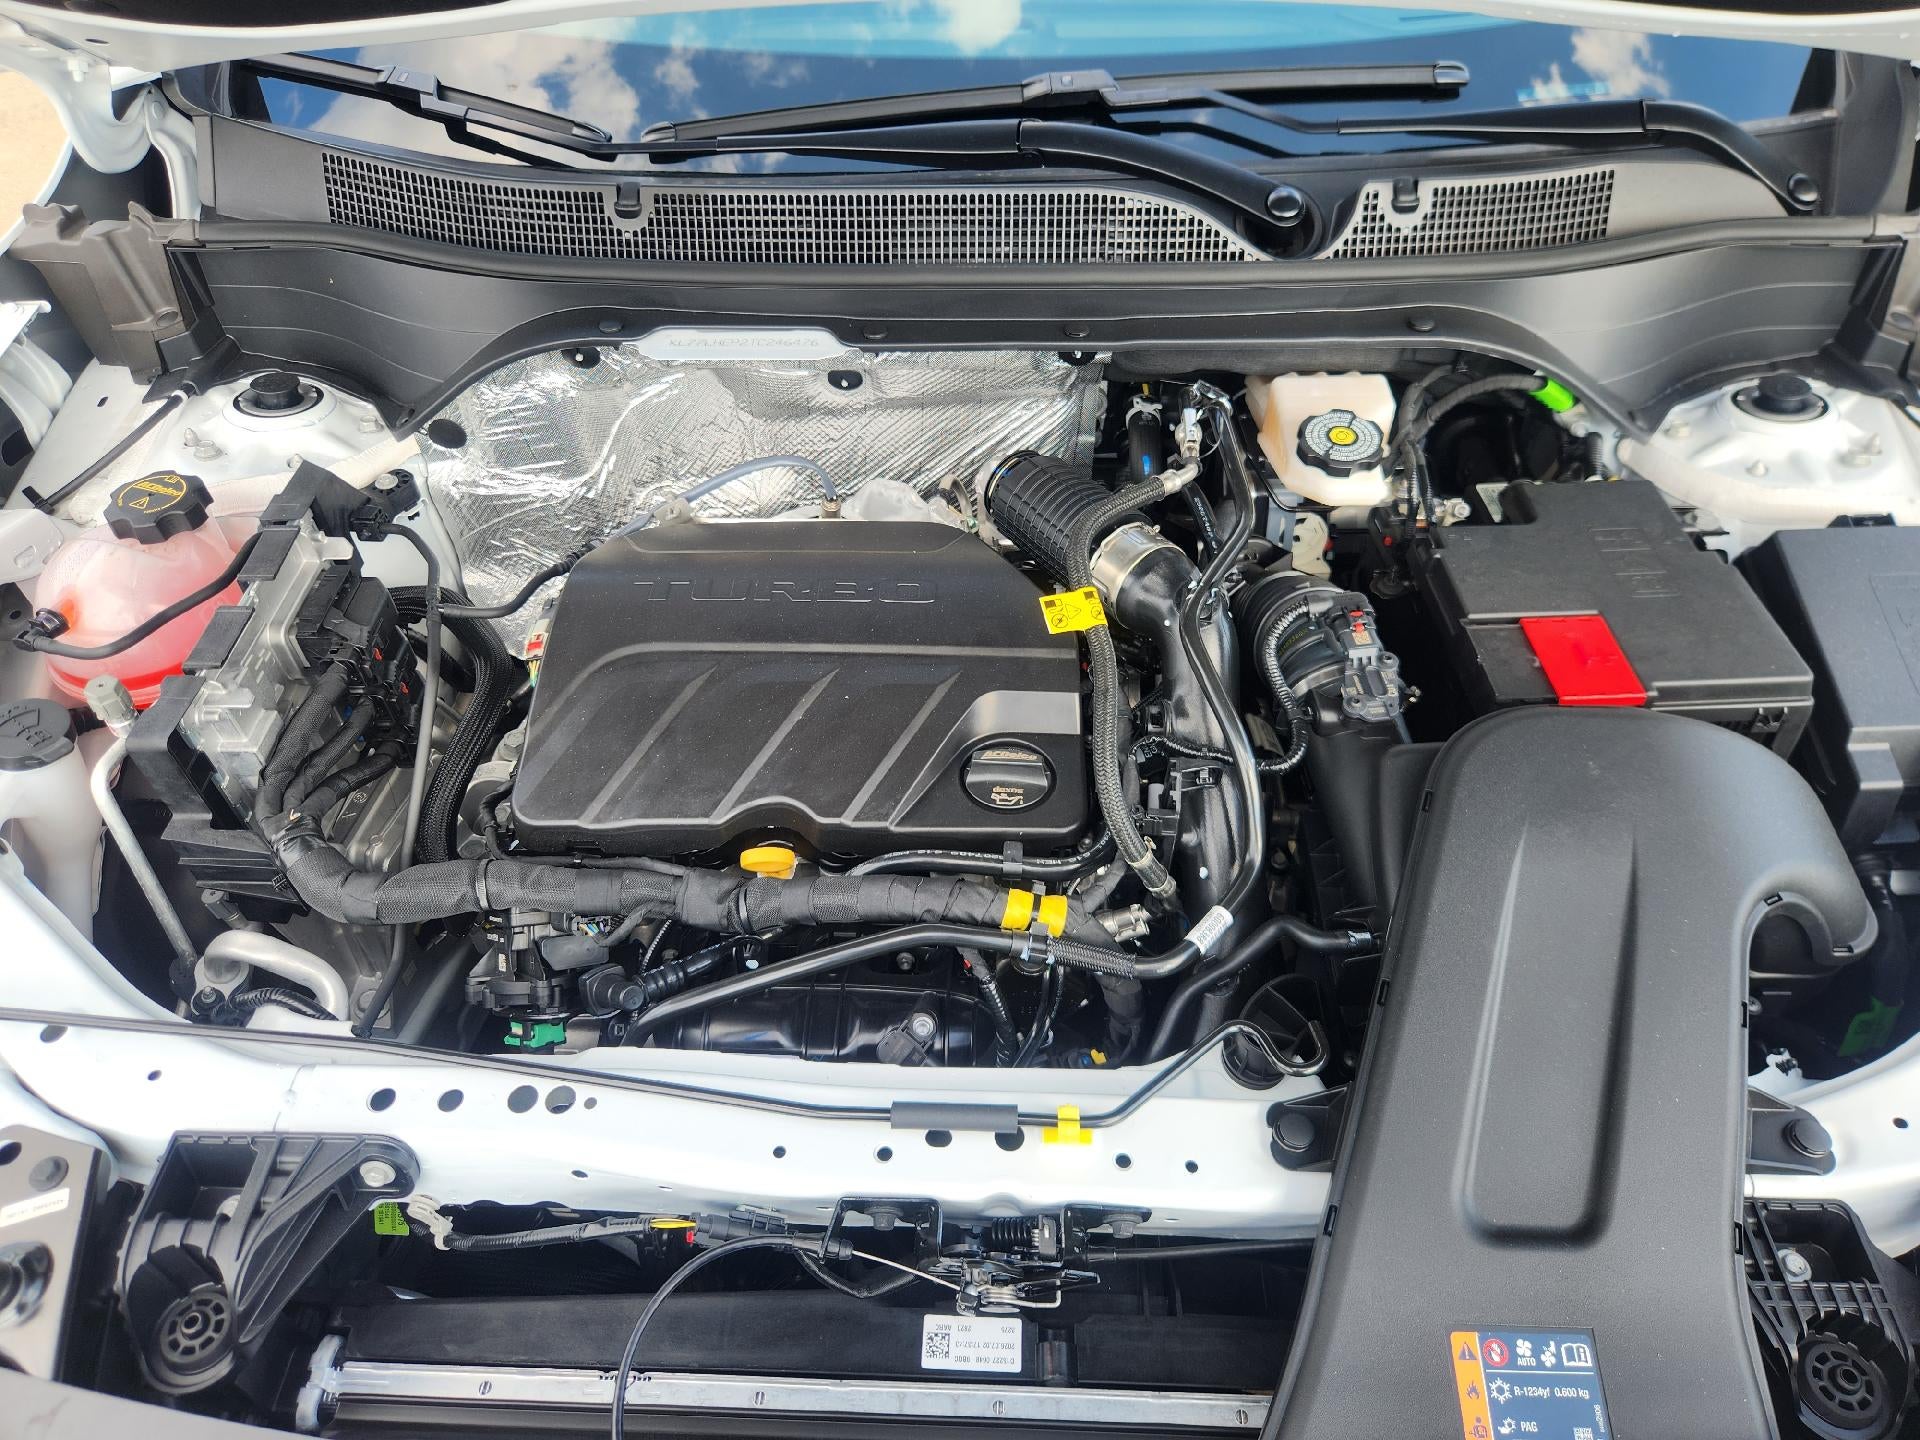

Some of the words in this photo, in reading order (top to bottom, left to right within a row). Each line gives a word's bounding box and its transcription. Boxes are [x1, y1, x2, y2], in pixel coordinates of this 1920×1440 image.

[633, 580, 935, 602] TURBO
[981, 751, 1038, 761] ACDelco
[1517, 1358, 1537, 1366] AUTO
[1513, 1385, 1550, 1398] R-1234yf
[1554, 1387, 1577, 1397] 0.600
[1578, 1387, 1590, 1399] kg
[1520, 1421, 1538, 1432] PAG
